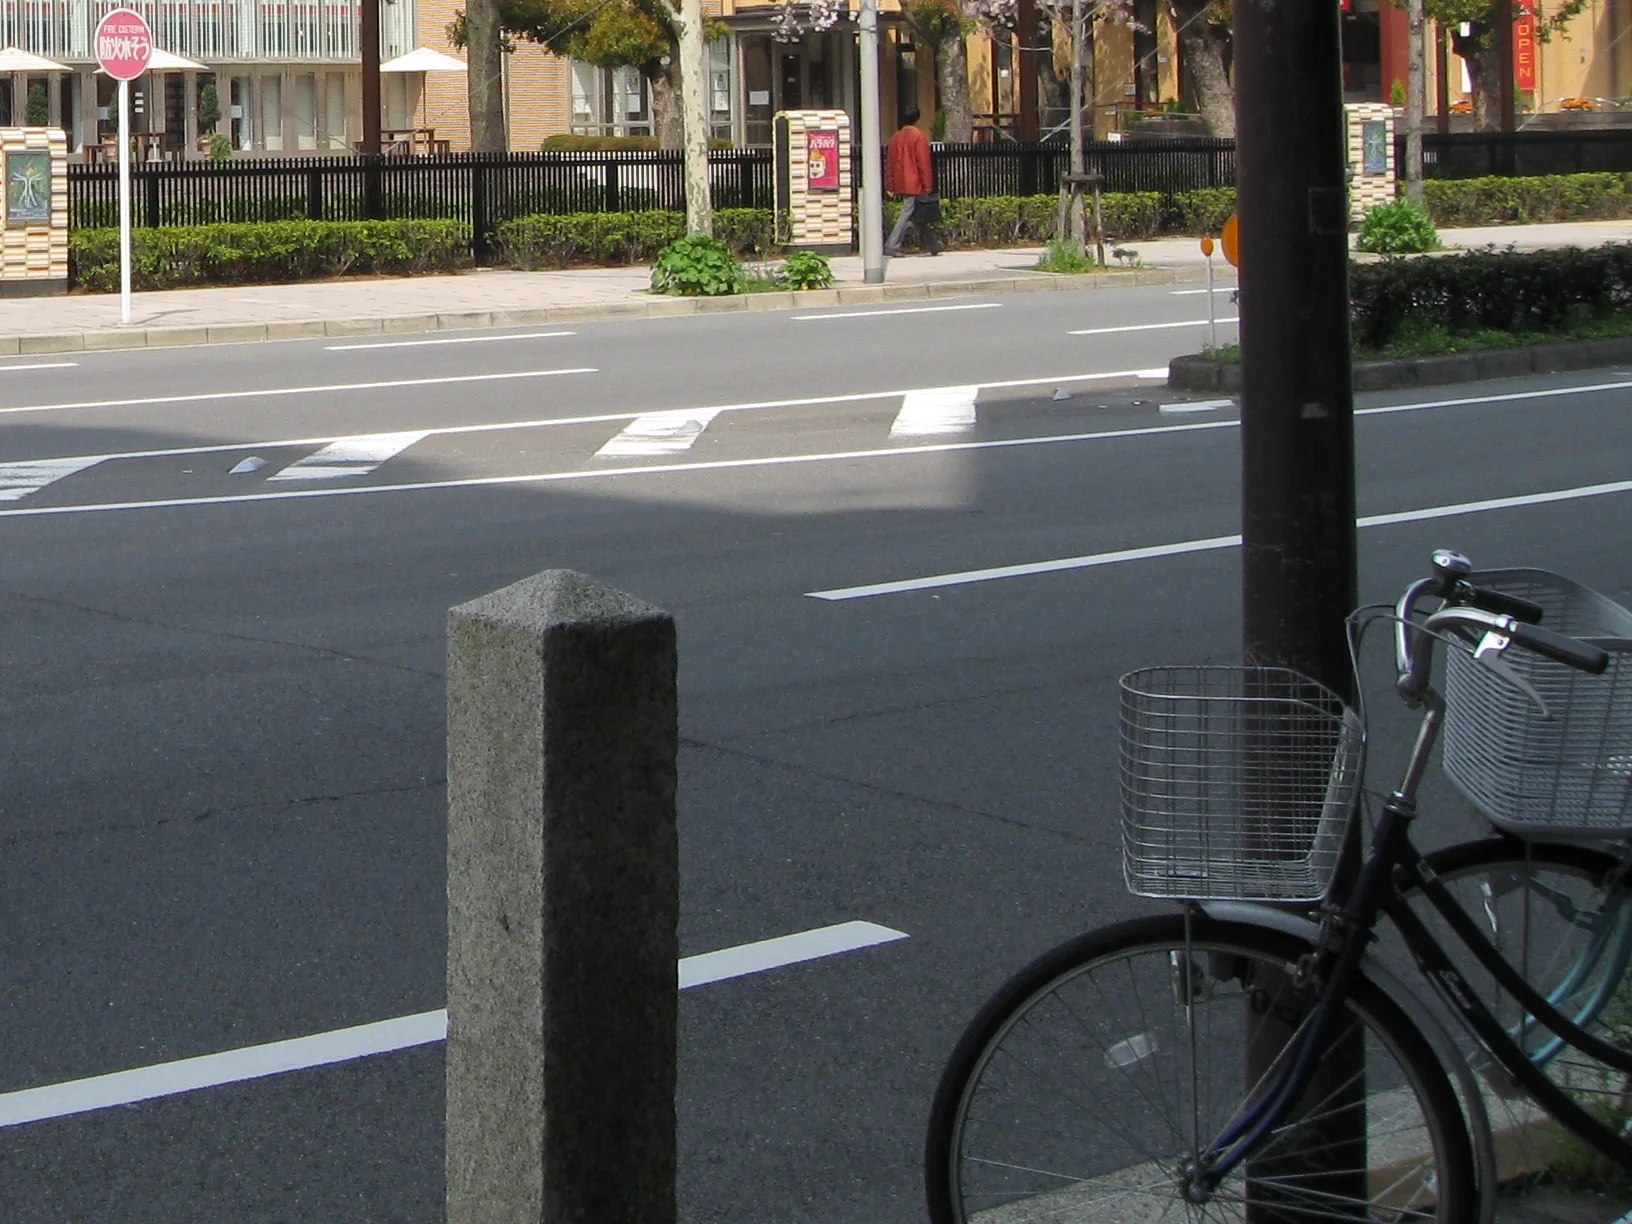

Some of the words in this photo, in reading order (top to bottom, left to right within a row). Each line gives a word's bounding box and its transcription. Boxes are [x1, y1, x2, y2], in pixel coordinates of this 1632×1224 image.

[103, 24, 117, 34] FIRE
[118, 24, 145, 34] CISTERN
[99, 35, 150, 61] 防火水そう
[1517, 24, 1531, 78] OPEN
